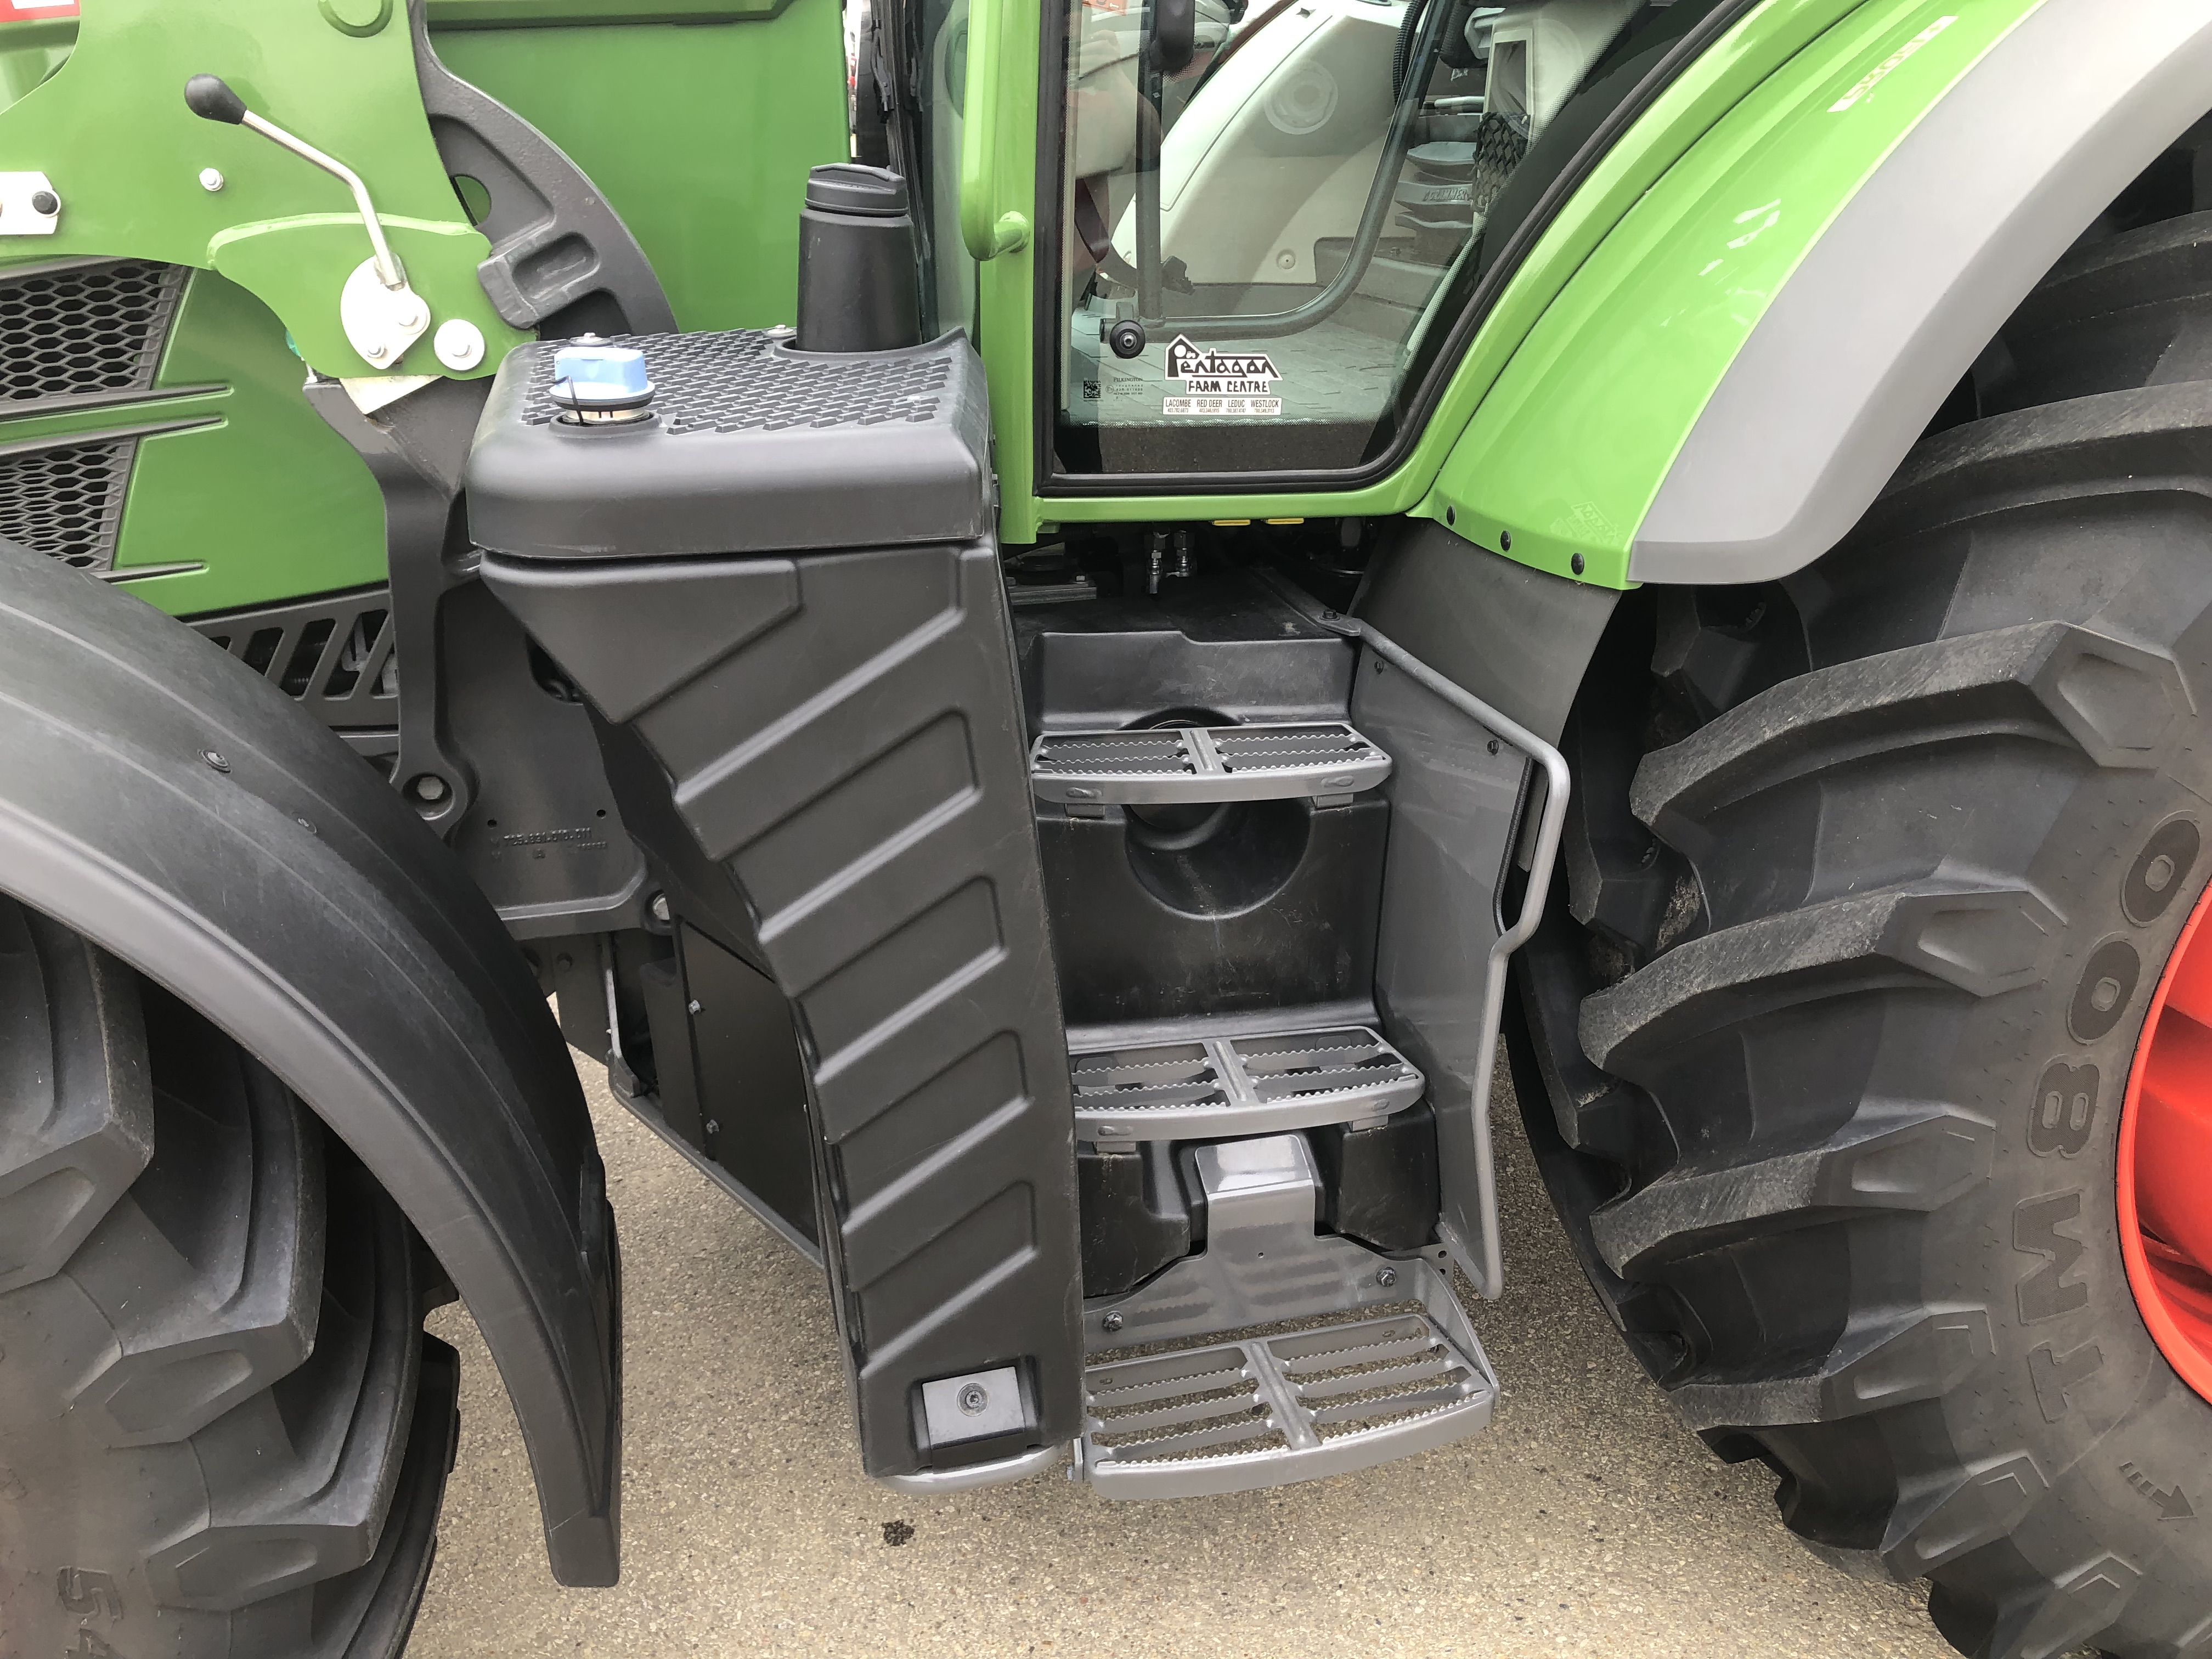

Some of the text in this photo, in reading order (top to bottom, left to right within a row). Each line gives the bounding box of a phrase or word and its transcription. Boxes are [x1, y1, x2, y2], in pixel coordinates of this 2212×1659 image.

[1429, 188, 1467, 201] GRAMMER
[1167, 338, 1279, 378] Pentagon
[1188, 380, 1268, 392] FARM CENTRE
[1197, 399, 1222, 408] RED DEER
[1228, 399, 1245, 408] LEDUC
[1250, 399, 1279, 408] WESTLOCK
